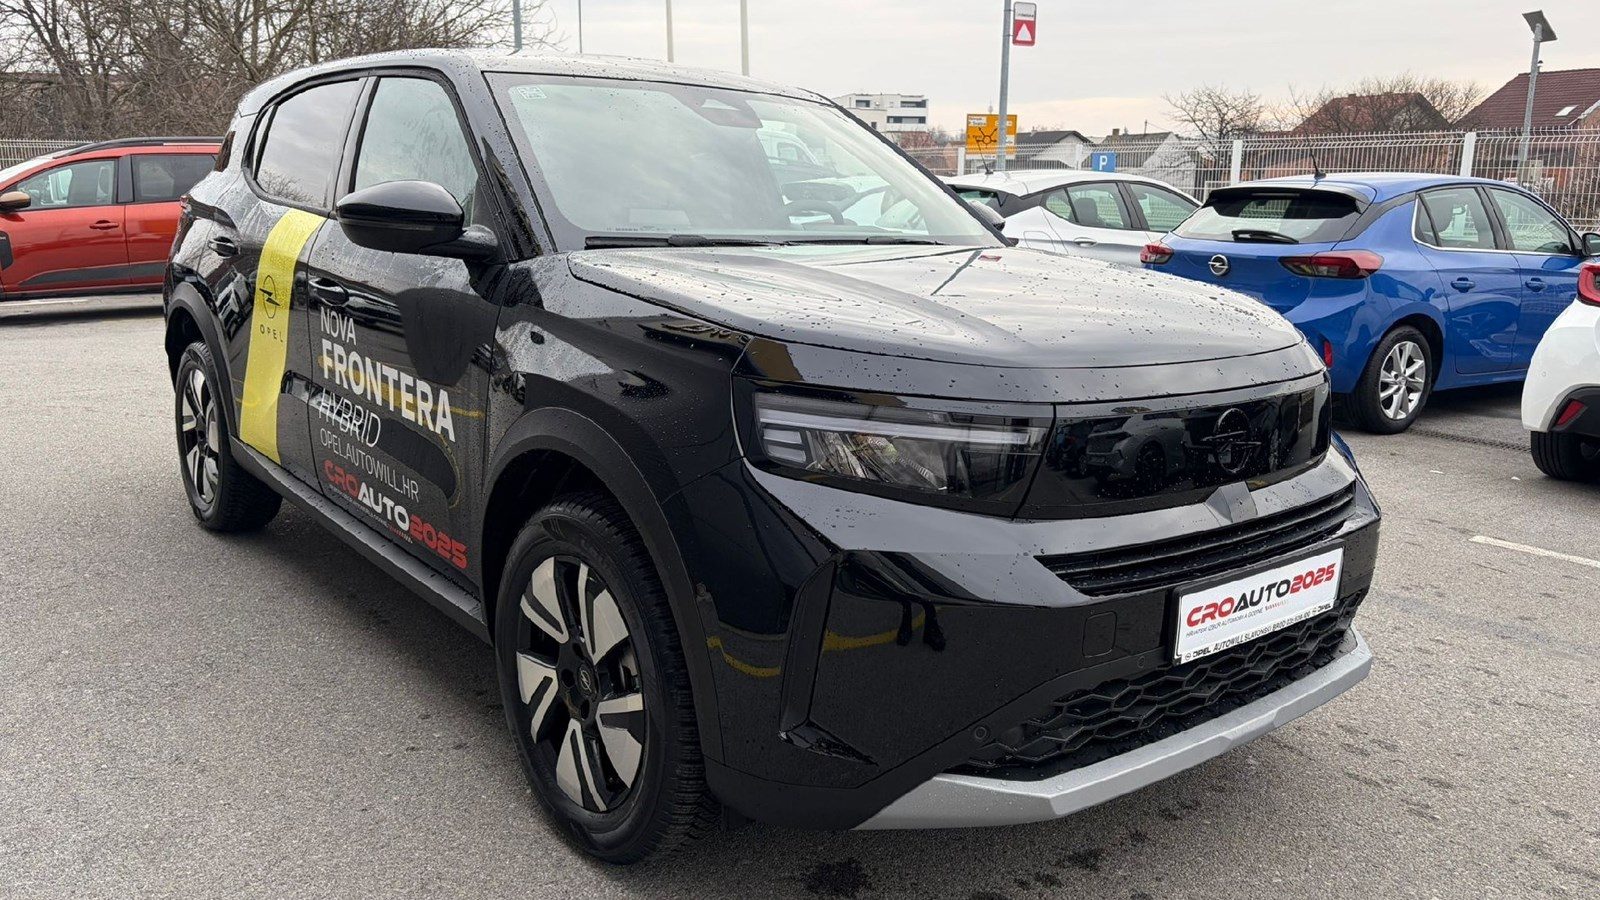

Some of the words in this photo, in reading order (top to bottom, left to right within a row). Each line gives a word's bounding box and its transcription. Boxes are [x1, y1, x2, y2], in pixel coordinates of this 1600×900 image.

[1099, 154, 1108, 169] P
[260, 324, 284, 343] OPEL
[320, 306, 357, 346] NOVA
[319, 387, 382, 448] HYBRID
[321, 338, 456, 443] FRONTERA
[319, 428, 420, 503] OPELAUTOWILL.HR
[323, 459, 469, 570] CROAUTO2025
[1186, 562, 1337, 628] CROAUTO2025
[1192, 647, 1211, 658] OPEL
[1213, 634, 1243, 652] AUTOWILL
